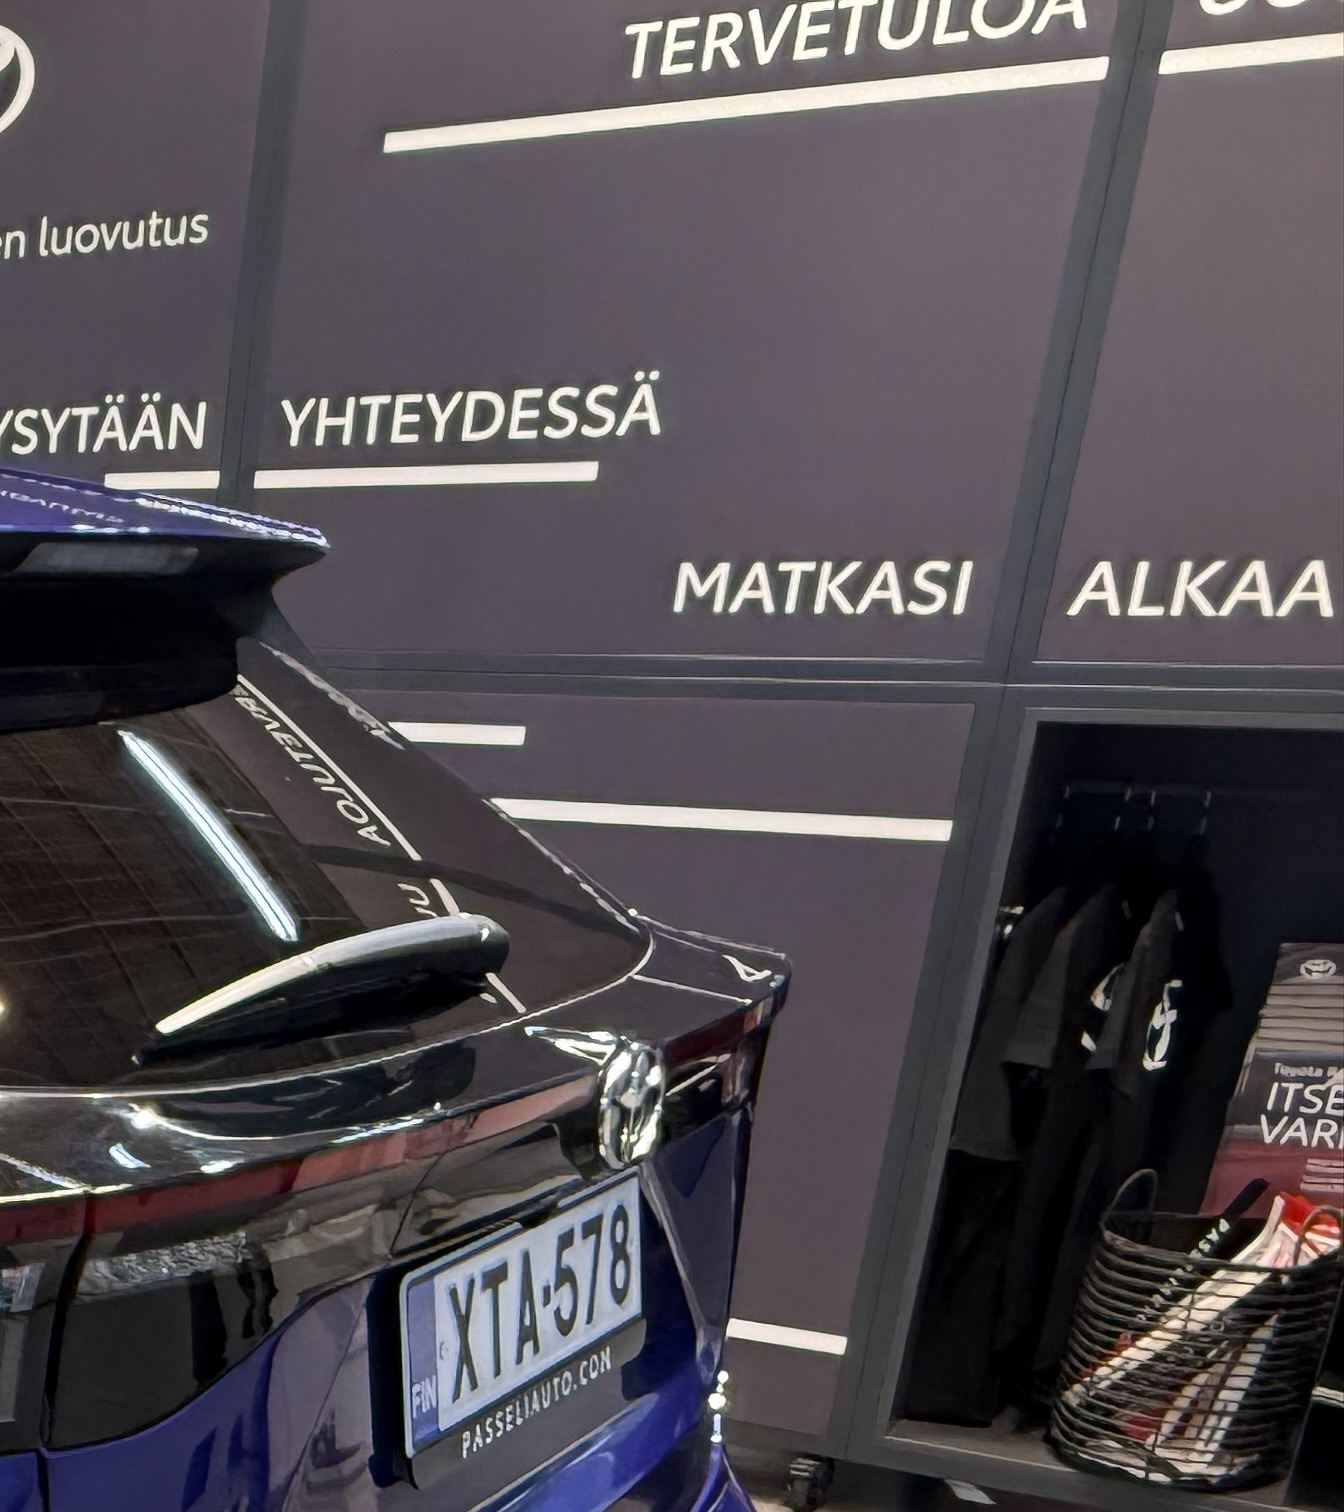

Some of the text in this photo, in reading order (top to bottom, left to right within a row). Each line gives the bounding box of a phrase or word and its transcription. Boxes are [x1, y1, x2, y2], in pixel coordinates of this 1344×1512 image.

[624, 0, 1087, 79] TERVETULOA
[38, 210, 211, 256] luovutus
[282, 370, 662, 448] YHTEYDESSÄ
[673, 559, 1335, 618] MATKASI ALKAA
[1260, 1113, 1344, 1150] VAR
[448, 1204, 631, 1404] XTA-578
[411, 1374, 437, 1419] FIN
[461, 1346, 613, 1459] PASSELIAUTO.COM
